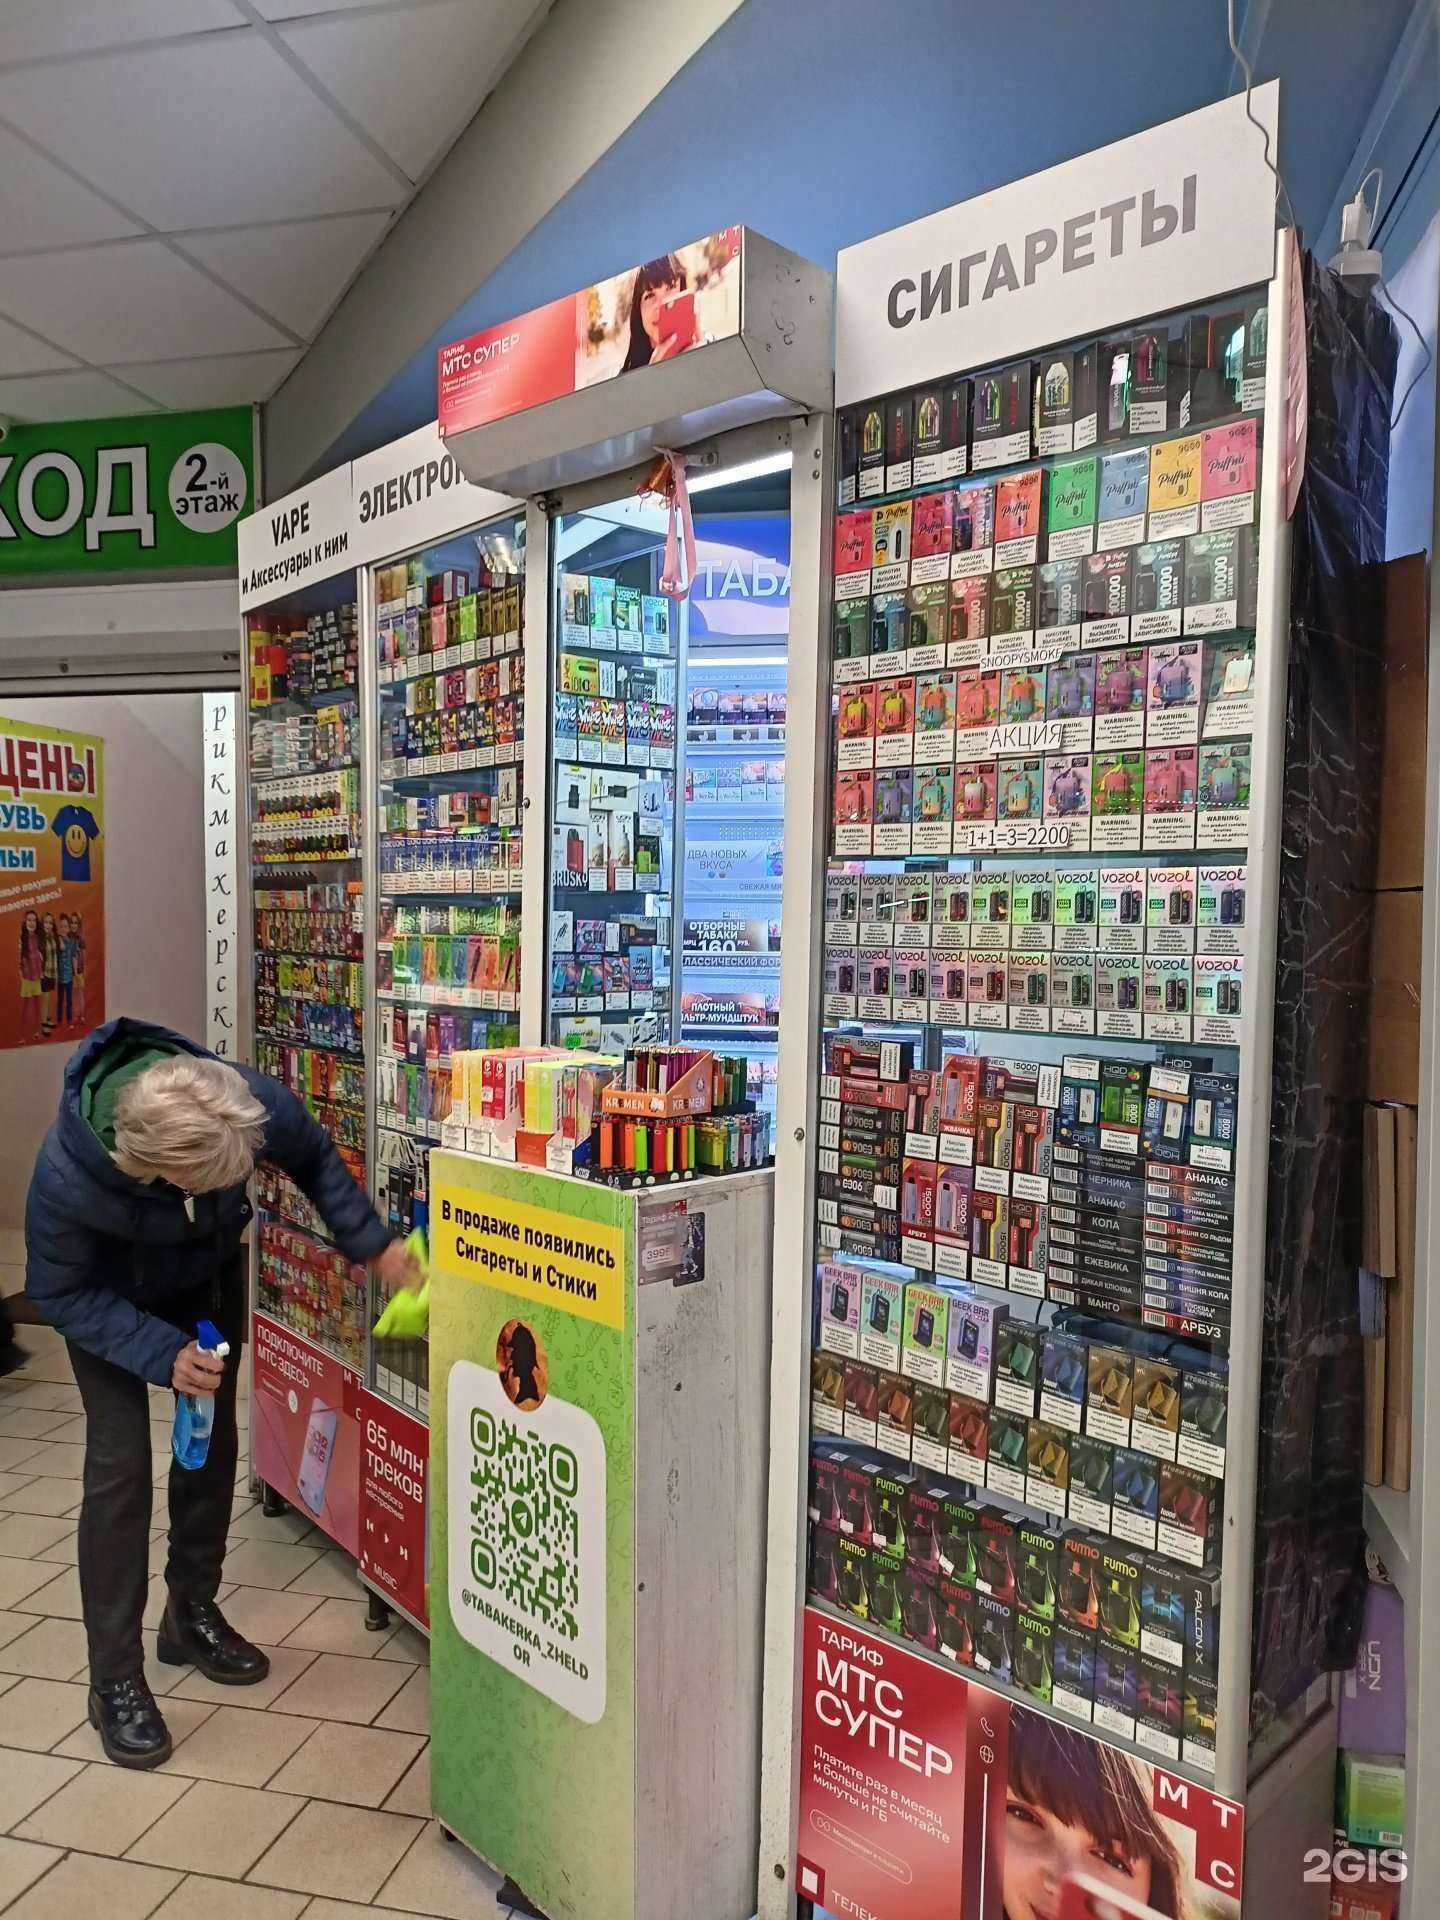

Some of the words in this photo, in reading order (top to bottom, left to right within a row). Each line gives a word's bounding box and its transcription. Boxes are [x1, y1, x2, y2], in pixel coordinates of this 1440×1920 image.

[886, 174, 1197, 329] СИГАРЕТЫ
[442, 351, 472, 377] МТС
[473, 333, 521, 365] СУПЕР
[175, 493, 239, 515] этаж
[271, 501, 310, 547] VAPE
[242, 577, 248, 595] и
[250, 550, 312, 591] Аксессуары
[314, 548, 323, 564] к
[324, 531, 348, 559] ним
[980, 648, 1062, 669] SNOOPYSMOKE
[989, 723, 1062, 750] АКЦИЯ
[687, 849, 709, 860] ДВА
[710, 849, 748, 859] НОВЫХ
[699, 860, 733, 870] ВКУСА
[689, 921, 746, 931] ОТБОРНЫЕ
[696, 930, 738, 940] ТАБАКИ
[691, 1002, 735, 1012] ПЛОТНЫЙ
[1013, 1061, 1038, 1071] 15000
[1088, 1174, 1131, 1190] ЧЕРНИКА
[1185, 1171, 1229, 1187] АНАНАС
[1087, 1195, 1126, 1209] АНАНАС
[442, 1199, 451, 1221] В
[455, 1207, 520, 1241] продаже
[524, 1227, 616, 1269] появились
[455, 1236, 528, 1276] Сигареты
[532, 1265, 542, 1283] и
[546, 1264, 597, 1300] Стики
[1084, 1256, 1129, 1273] ЕЖЕВИКА
[1178, 1283, 1207, 1295] ВИШНЯ
[1087, 1297, 1120, 1312] МАНГО
[1180, 1320, 1222, 1338] АРБУЗ
[257, 1324, 324, 1377] ПОДКЛЮЧИТЕ
[257, 1343, 278, 1367] МТС
[277, 1351, 310, 1388] ЗДЕСЬ
[366, 1419, 387, 1451] 65
[390, 1438, 424, 1478] млн
[366, 1448, 423, 1504] треков
[373, 1562, 398, 1591] MUSIC
[461, 1588, 589, 1681] @TABAKERKA_ZHELD
[818, 1624, 884, 1667] ТАРИФ
[513, 1644, 531, 1668] OR
[816, 1649, 903, 1719] МТС
[815, 1689, 953, 1778] СУПЕР
[813, 1773, 859, 1806] минуты
[861, 1802, 869, 1813] и
[871, 1806, 888, 1824] ГБ
[814, 1744, 863, 1780] Платите
[865, 1774, 888, 1795] раз
[891, 1788, 898, 1799] в
[901, 1793, 942, 1827] месяц
[813, 1760, 821, 1771] и
[823, 1761, 870, 1800] больше
[872, 1793, 887, 1809] не
[889, 1803, 950, 1844] считайте
[1160, 1775, 1188, 1810] М
[1212, 1799, 1237, 1829] Т
[1210, 1859, 1236, 1889] С
